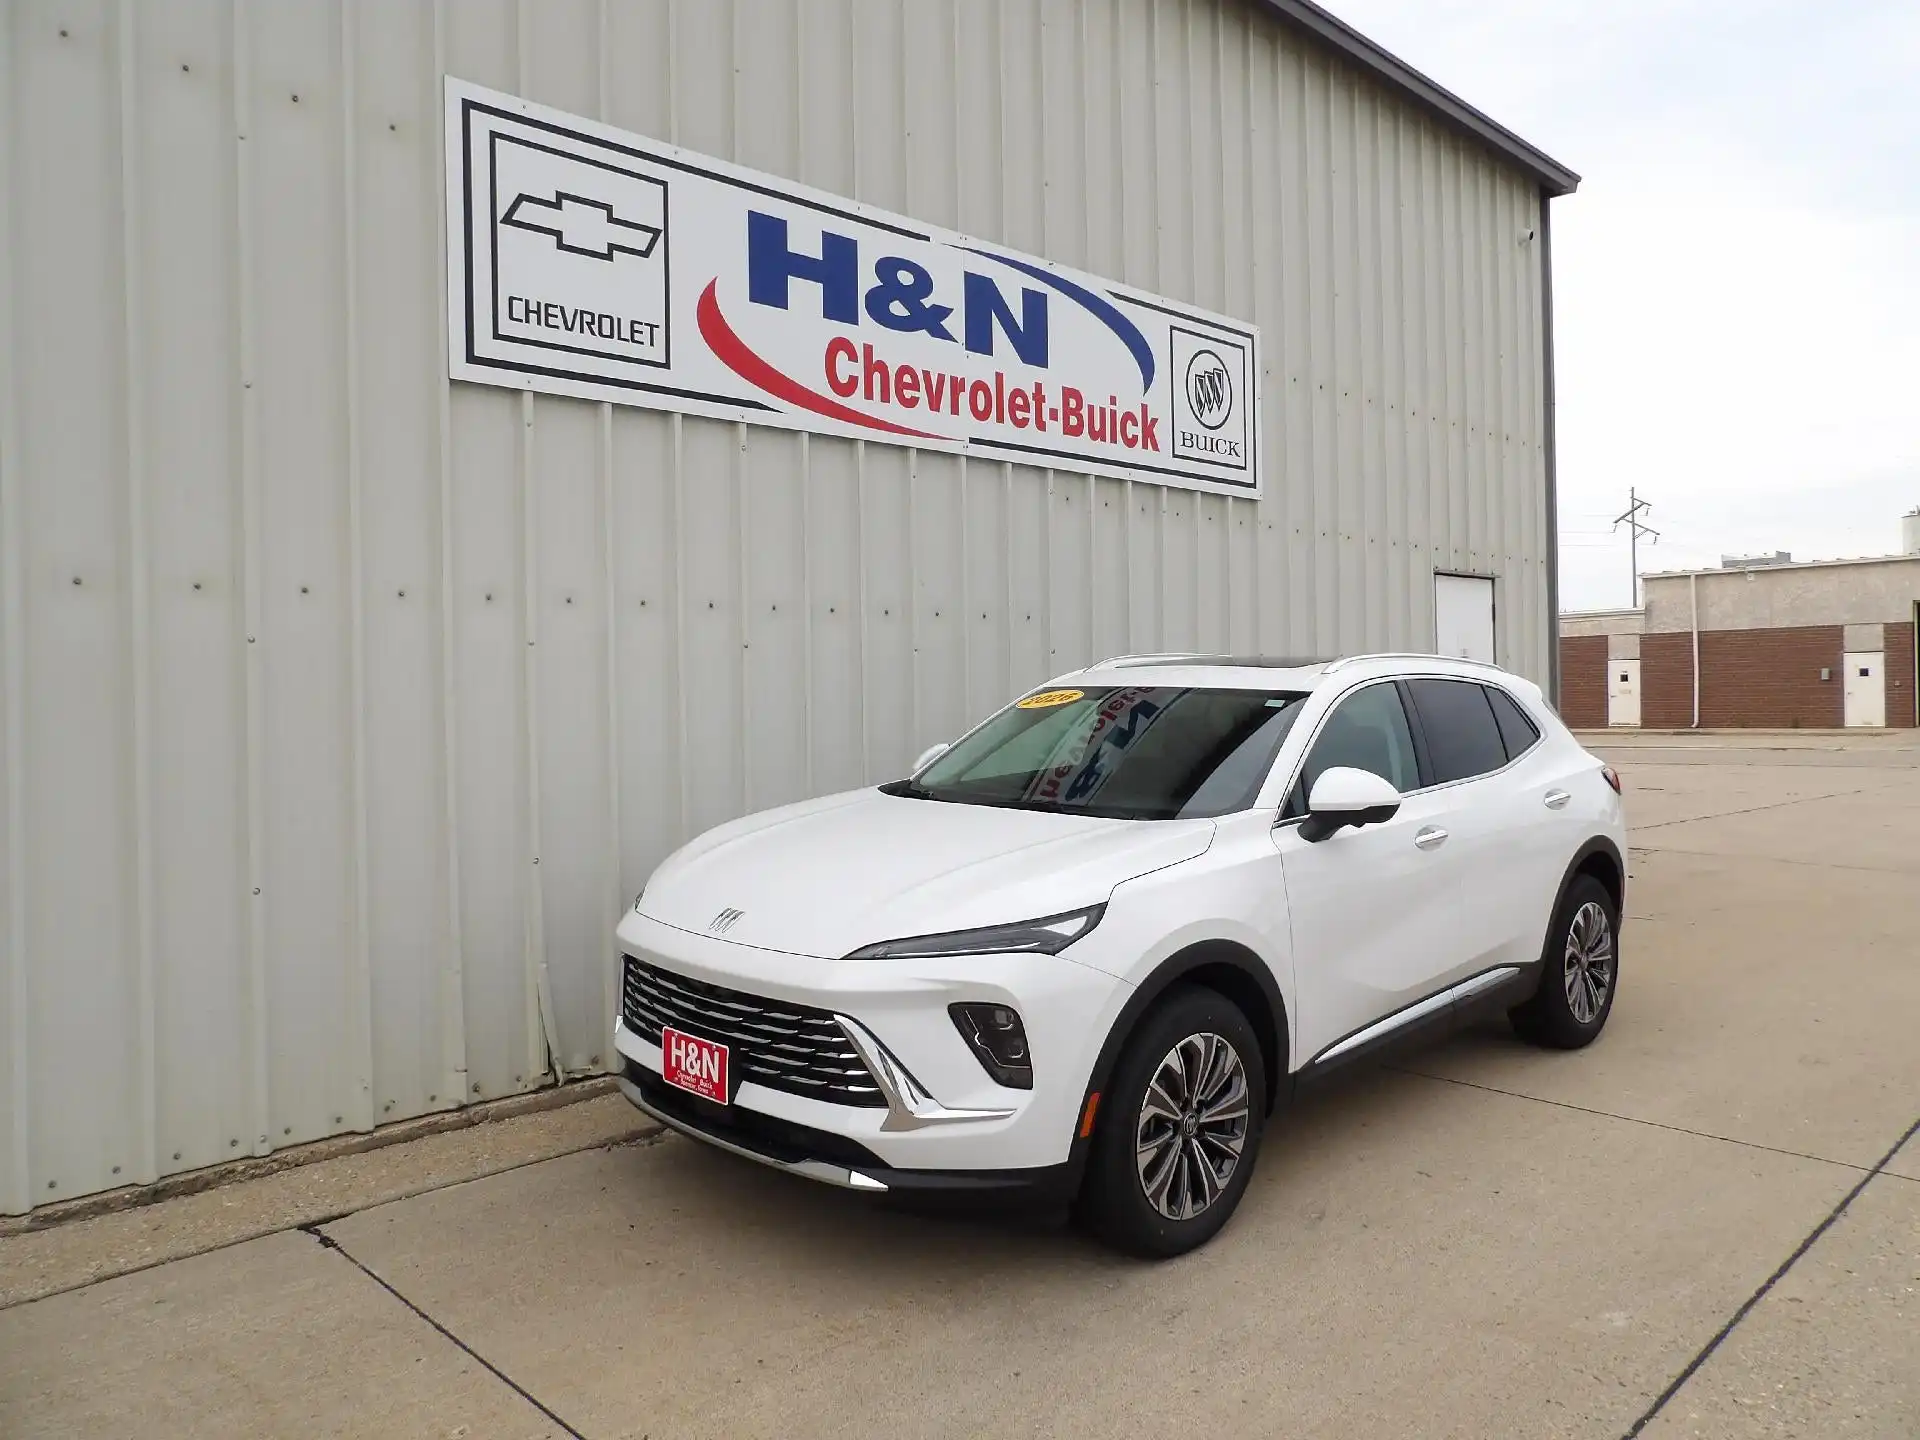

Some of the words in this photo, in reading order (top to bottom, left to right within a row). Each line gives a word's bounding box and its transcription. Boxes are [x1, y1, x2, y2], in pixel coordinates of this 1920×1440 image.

[748, 211, 1048, 368] H&N
[508, 295, 660, 348] CHEVROLET
[824, 336, 1160, 452] Chevrolet-Buick
[1180, 430, 1241, 458] BUICK
[671, 1036, 719, 1083] H&N
